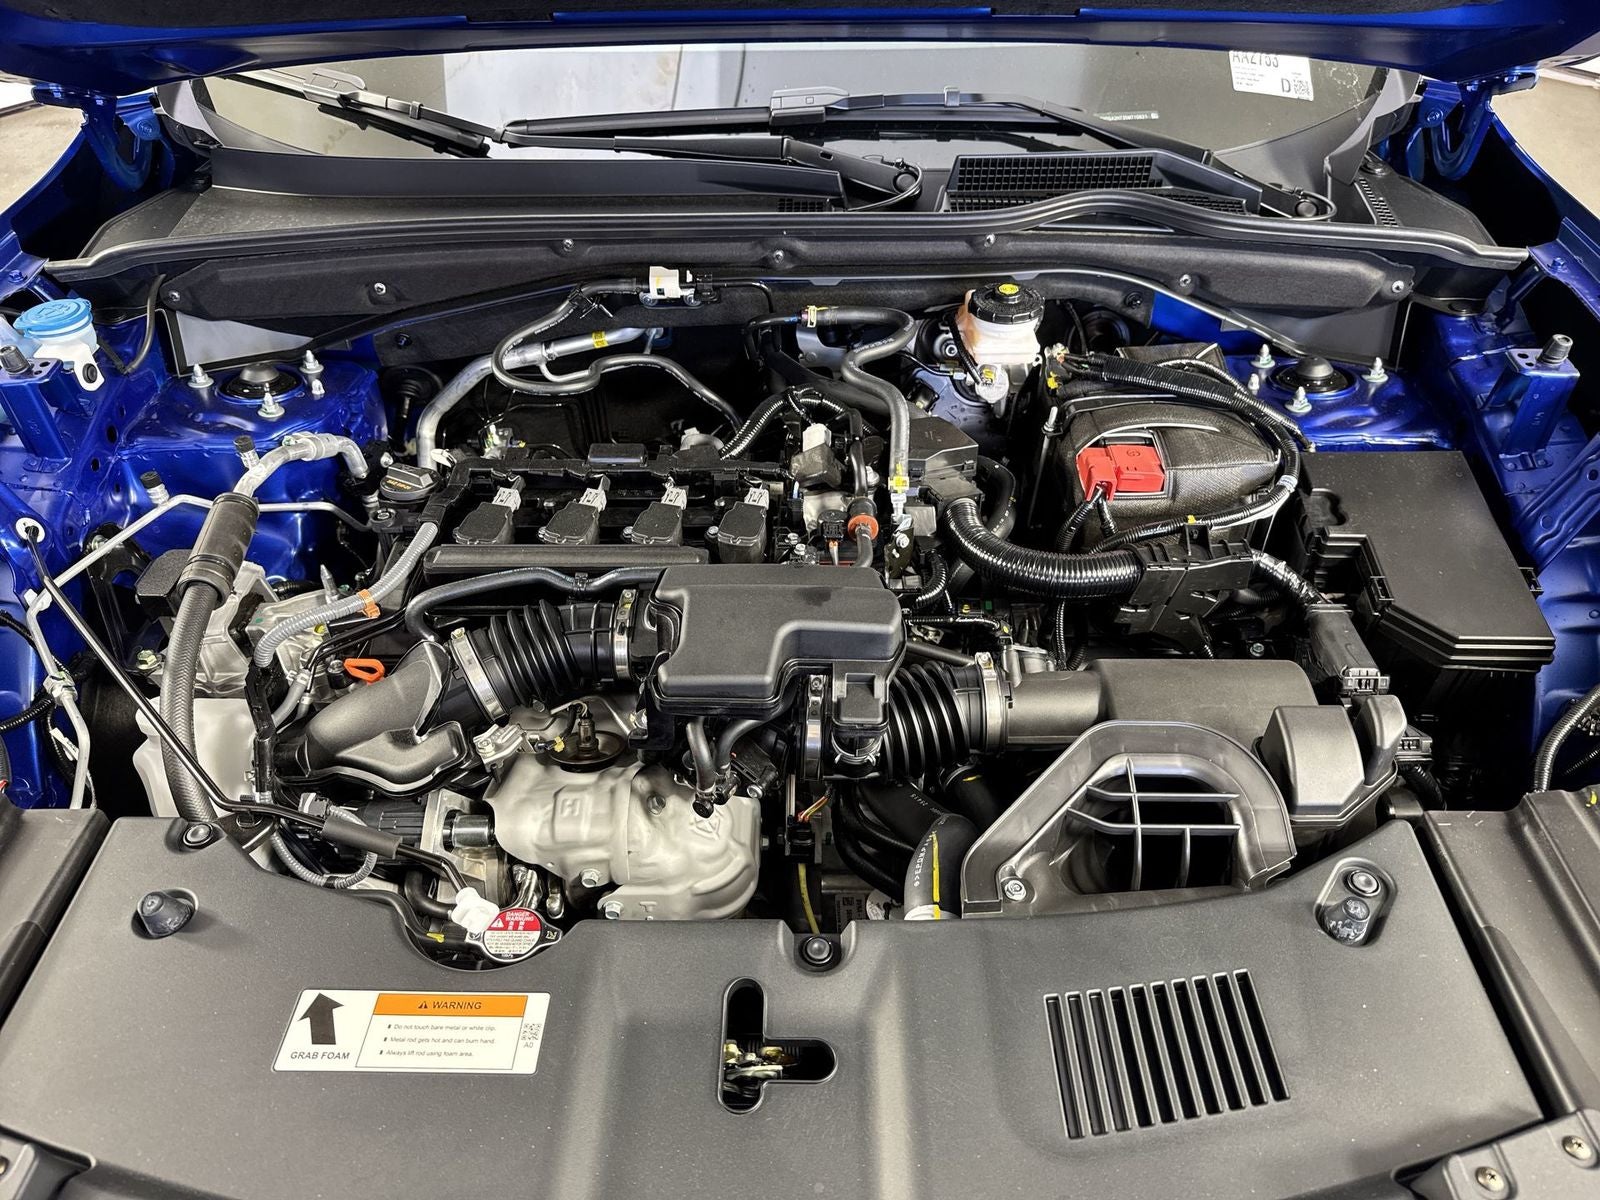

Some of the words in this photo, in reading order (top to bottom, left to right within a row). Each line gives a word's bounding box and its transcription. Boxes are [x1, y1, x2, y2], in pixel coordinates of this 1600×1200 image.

[1281, 78, 1291, 93] D
[432, 1001, 482, 1010] WARNING
[290, 1051, 319, 1060] GRAB
[320, 1051, 350, 1060] FOAM
